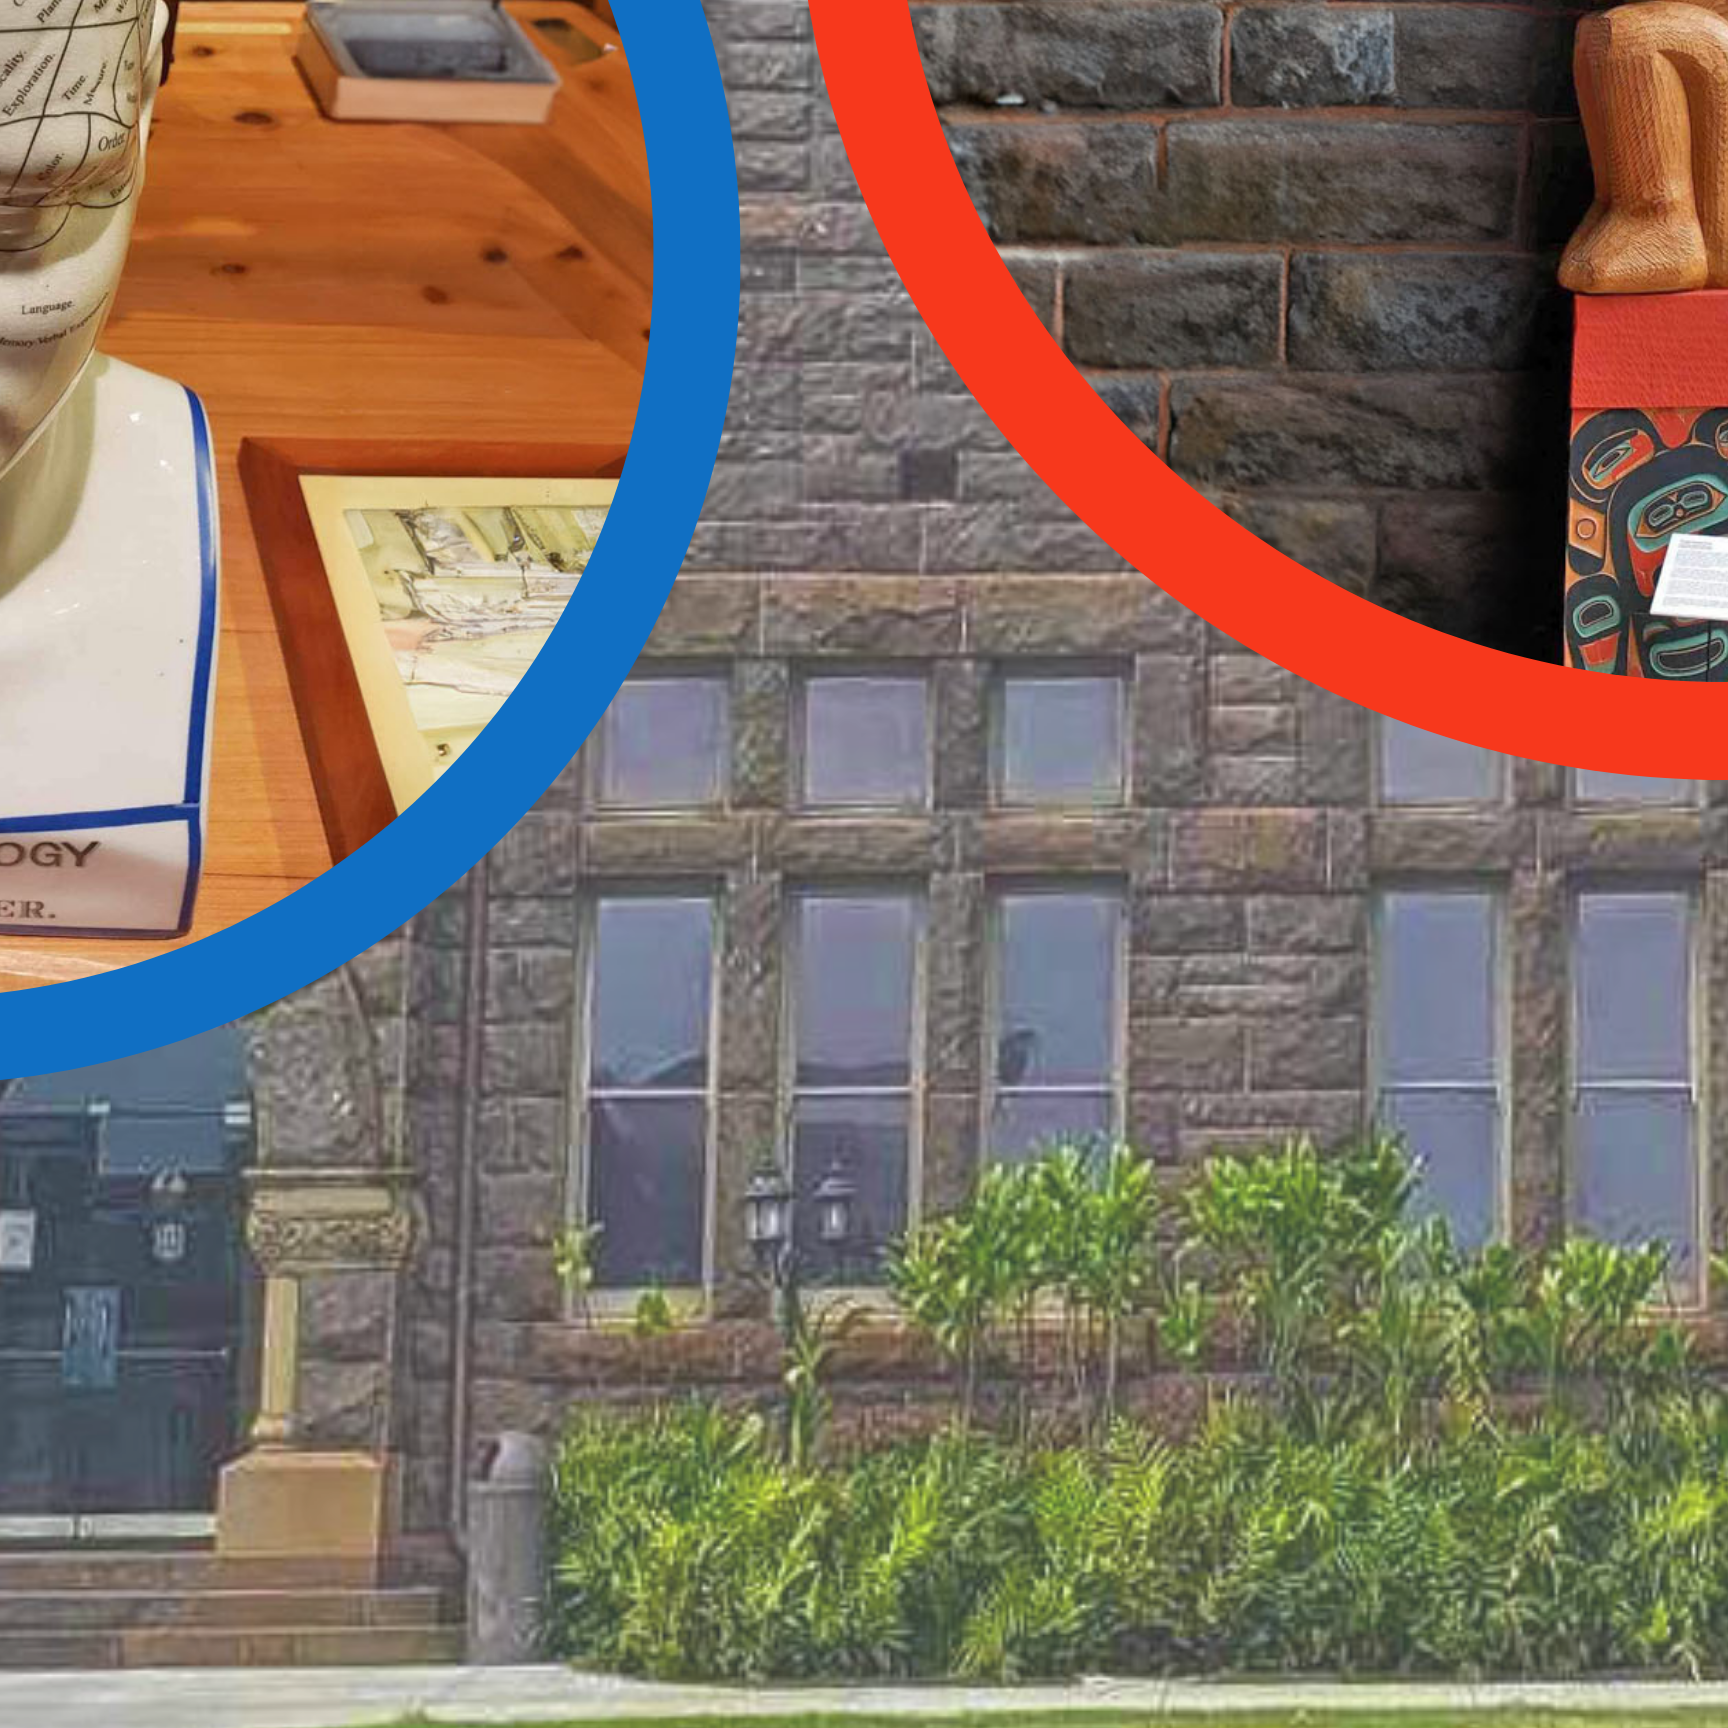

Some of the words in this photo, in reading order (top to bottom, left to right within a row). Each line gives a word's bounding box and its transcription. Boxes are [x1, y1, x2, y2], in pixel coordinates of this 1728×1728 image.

[2, 53, 56, 117] Exploration.
[62, 74, 88, 101] Time.
[21, 299, 75, 315] Language.
